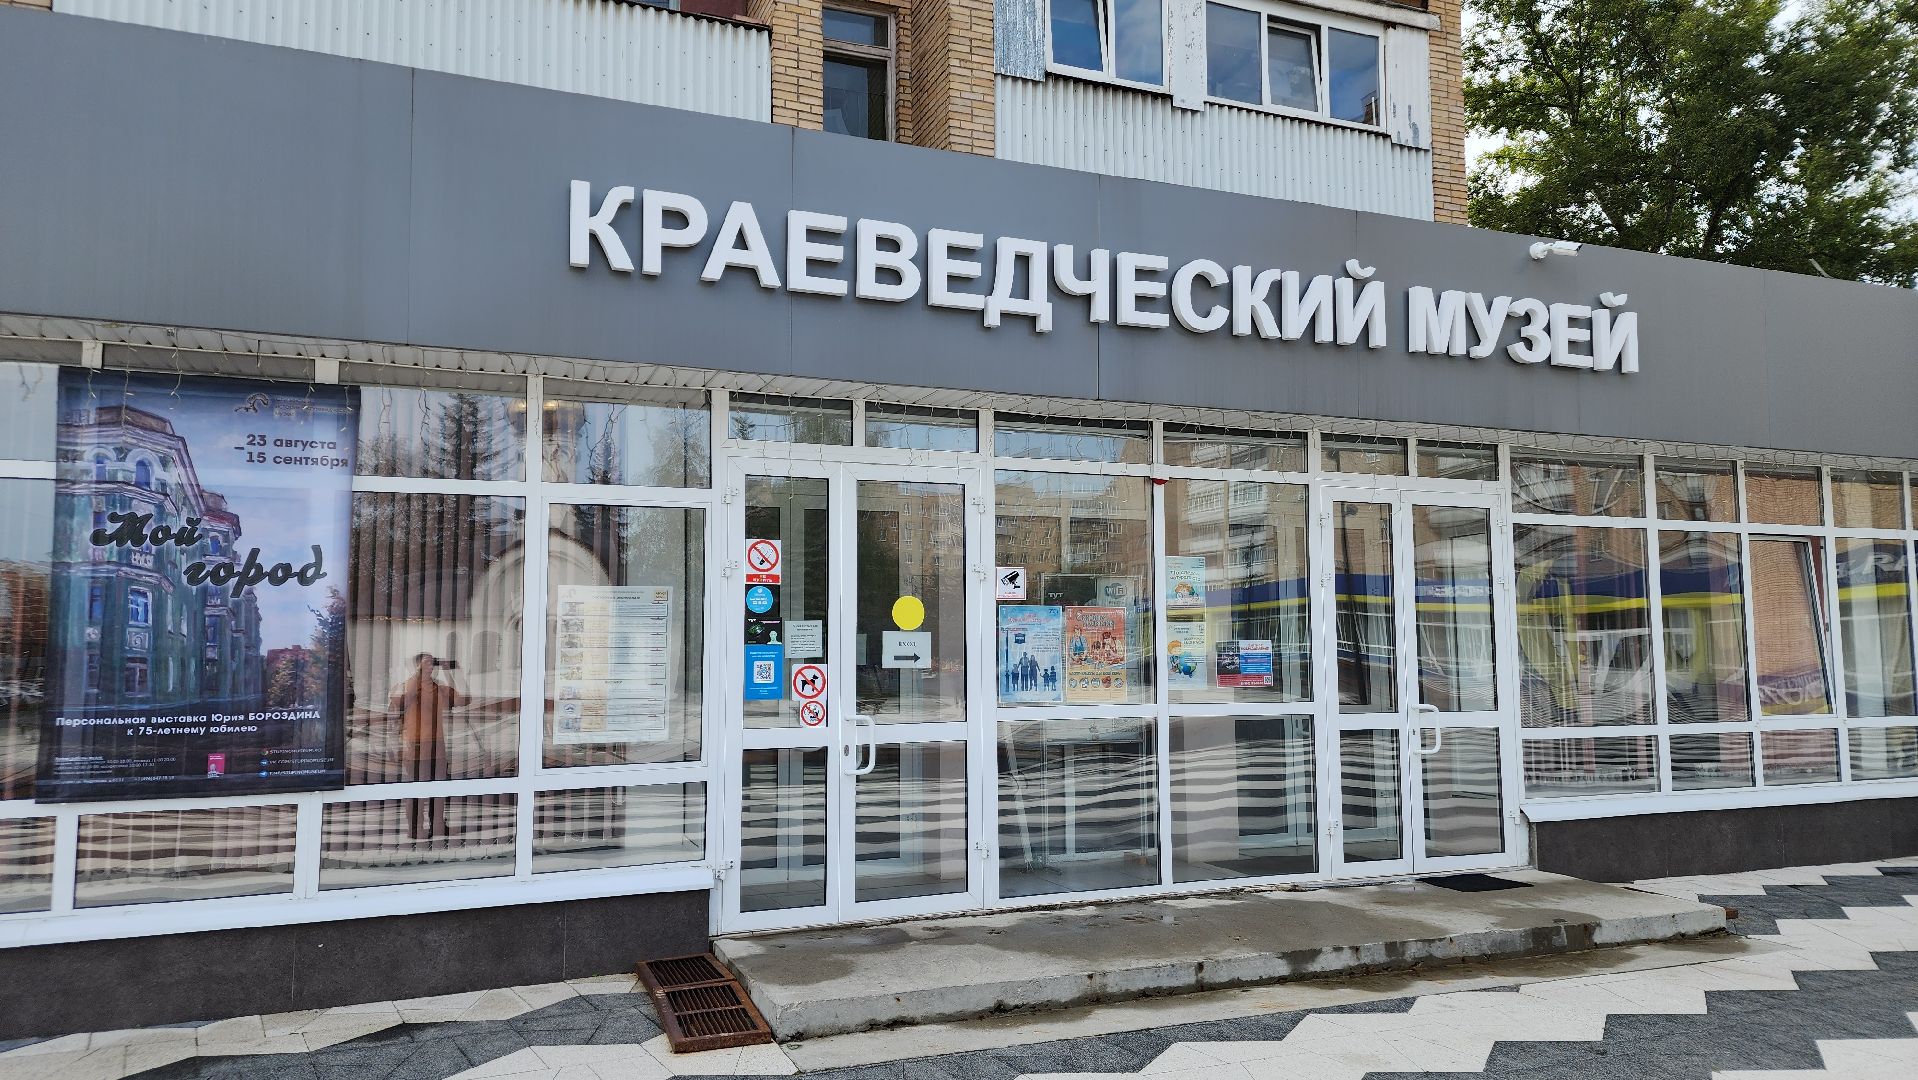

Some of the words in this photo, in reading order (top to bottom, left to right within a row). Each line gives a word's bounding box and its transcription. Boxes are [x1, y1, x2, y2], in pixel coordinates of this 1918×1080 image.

[568, 178, 1388, 350] КРАЕВЕДЧЕСКИЙ
[1407, 284, 1640, 375] МУЗЕЙ
[246, 434, 267, 447] 23
[273, 438, 337, 452] августа
[273, 455, 348, 470] сентября
[89, 511, 203, 548] Мой
[182, 545, 328, 599] город
[55, 716, 146, 728] Персональная
[151, 714, 207, 724] выставка
[211, 713, 245, 724] Юрия
[248, 711, 321, 721] БОРОЗДИНА
[127, 728, 134, 736] к
[138, 725, 206, 736] 75-летнему
[210, 724, 258, 734] юбилею
